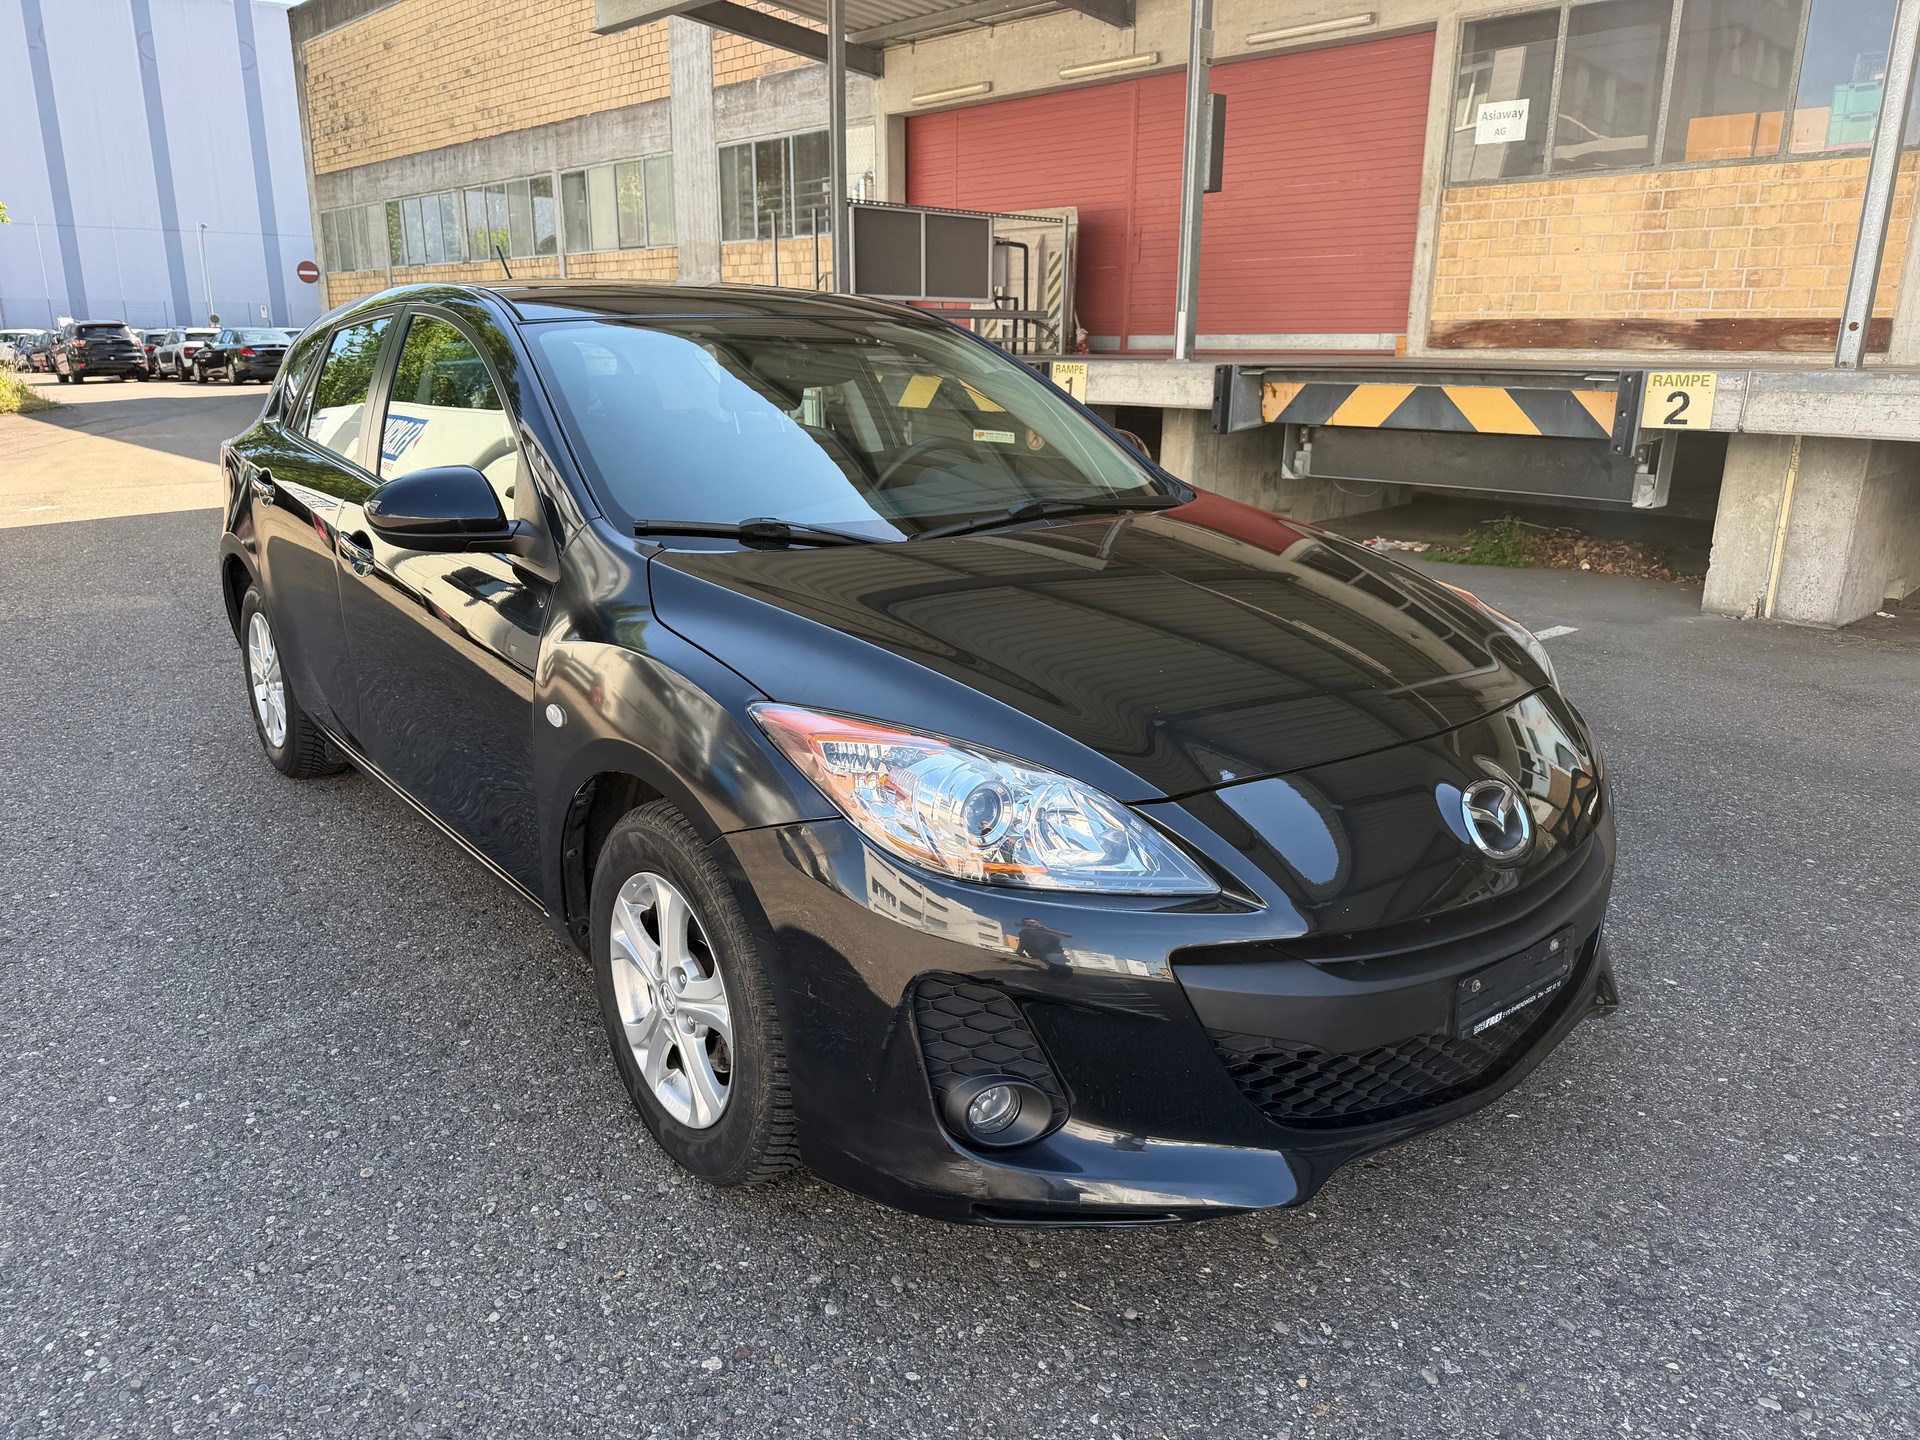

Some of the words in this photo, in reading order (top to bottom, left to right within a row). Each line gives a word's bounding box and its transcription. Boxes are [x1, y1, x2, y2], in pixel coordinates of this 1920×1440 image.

[1480, 109, 1525, 122] Asiaway
[1493, 127, 1507, 137] AG
[1055, 364, 1085, 375] RAMPE
[1065, 376, 1073, 396] 1
[1652, 374, 1711, 387] RAMPE
[1663, 390, 1690, 425] 2
